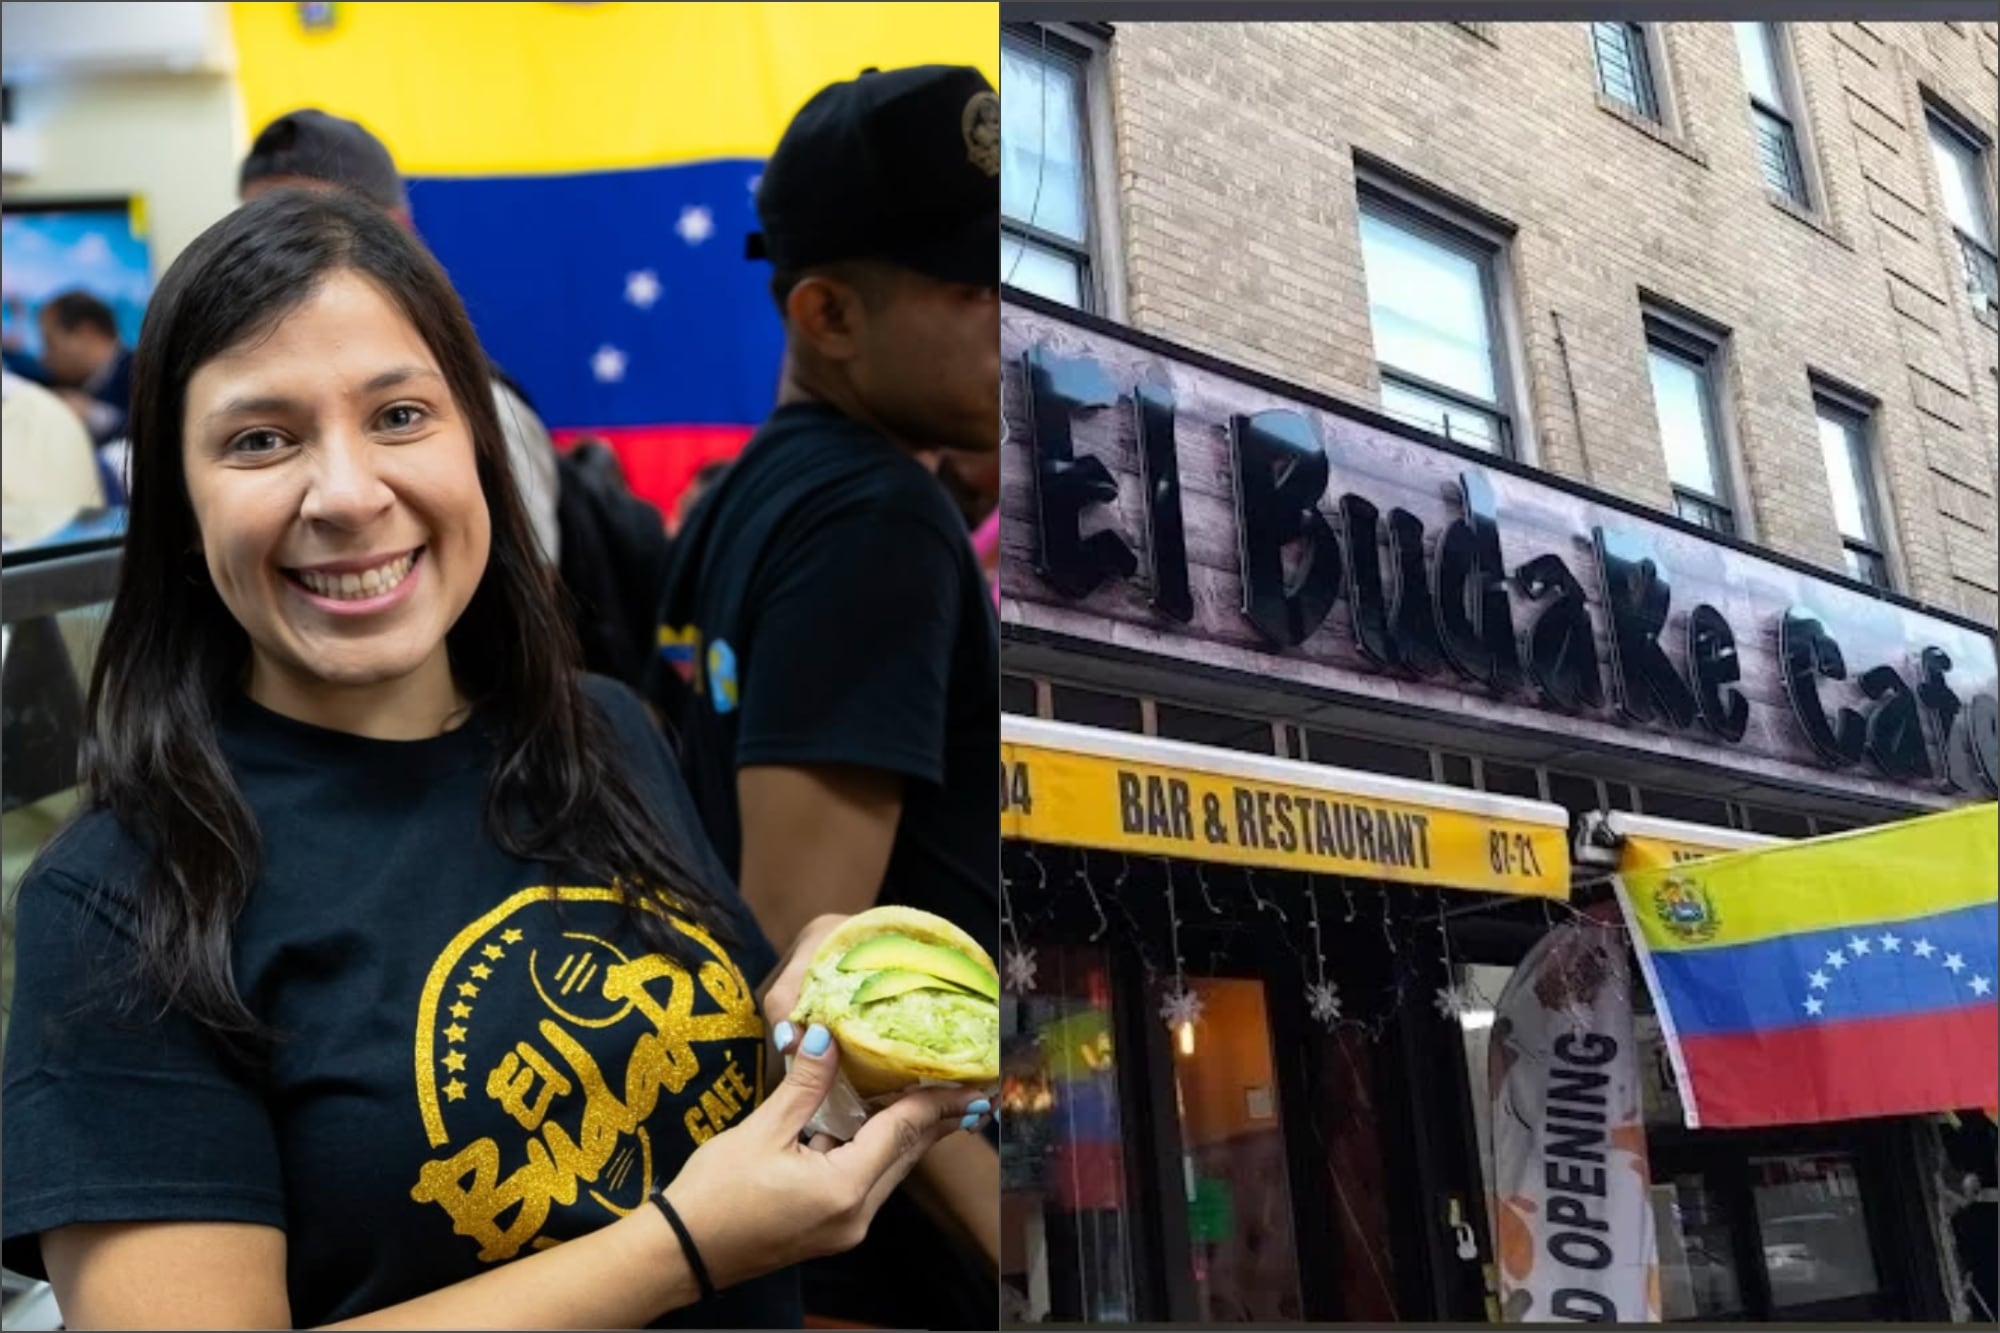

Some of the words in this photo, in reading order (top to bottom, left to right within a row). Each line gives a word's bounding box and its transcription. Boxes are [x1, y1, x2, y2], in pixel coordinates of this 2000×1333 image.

[1022, 345, 1194, 623] El
[1118, 770, 1194, 841] BAR
[1203, 792, 1229, 845] &
[1233, 786, 1431, 870] RESTAURANT
[1489, 829, 1542, 877] 87-21
[486, 1041, 572, 1131] El
[684, 1049, 754, 1147] CAFÉ
[1545, 1032, 1618, 1271] OPENING
